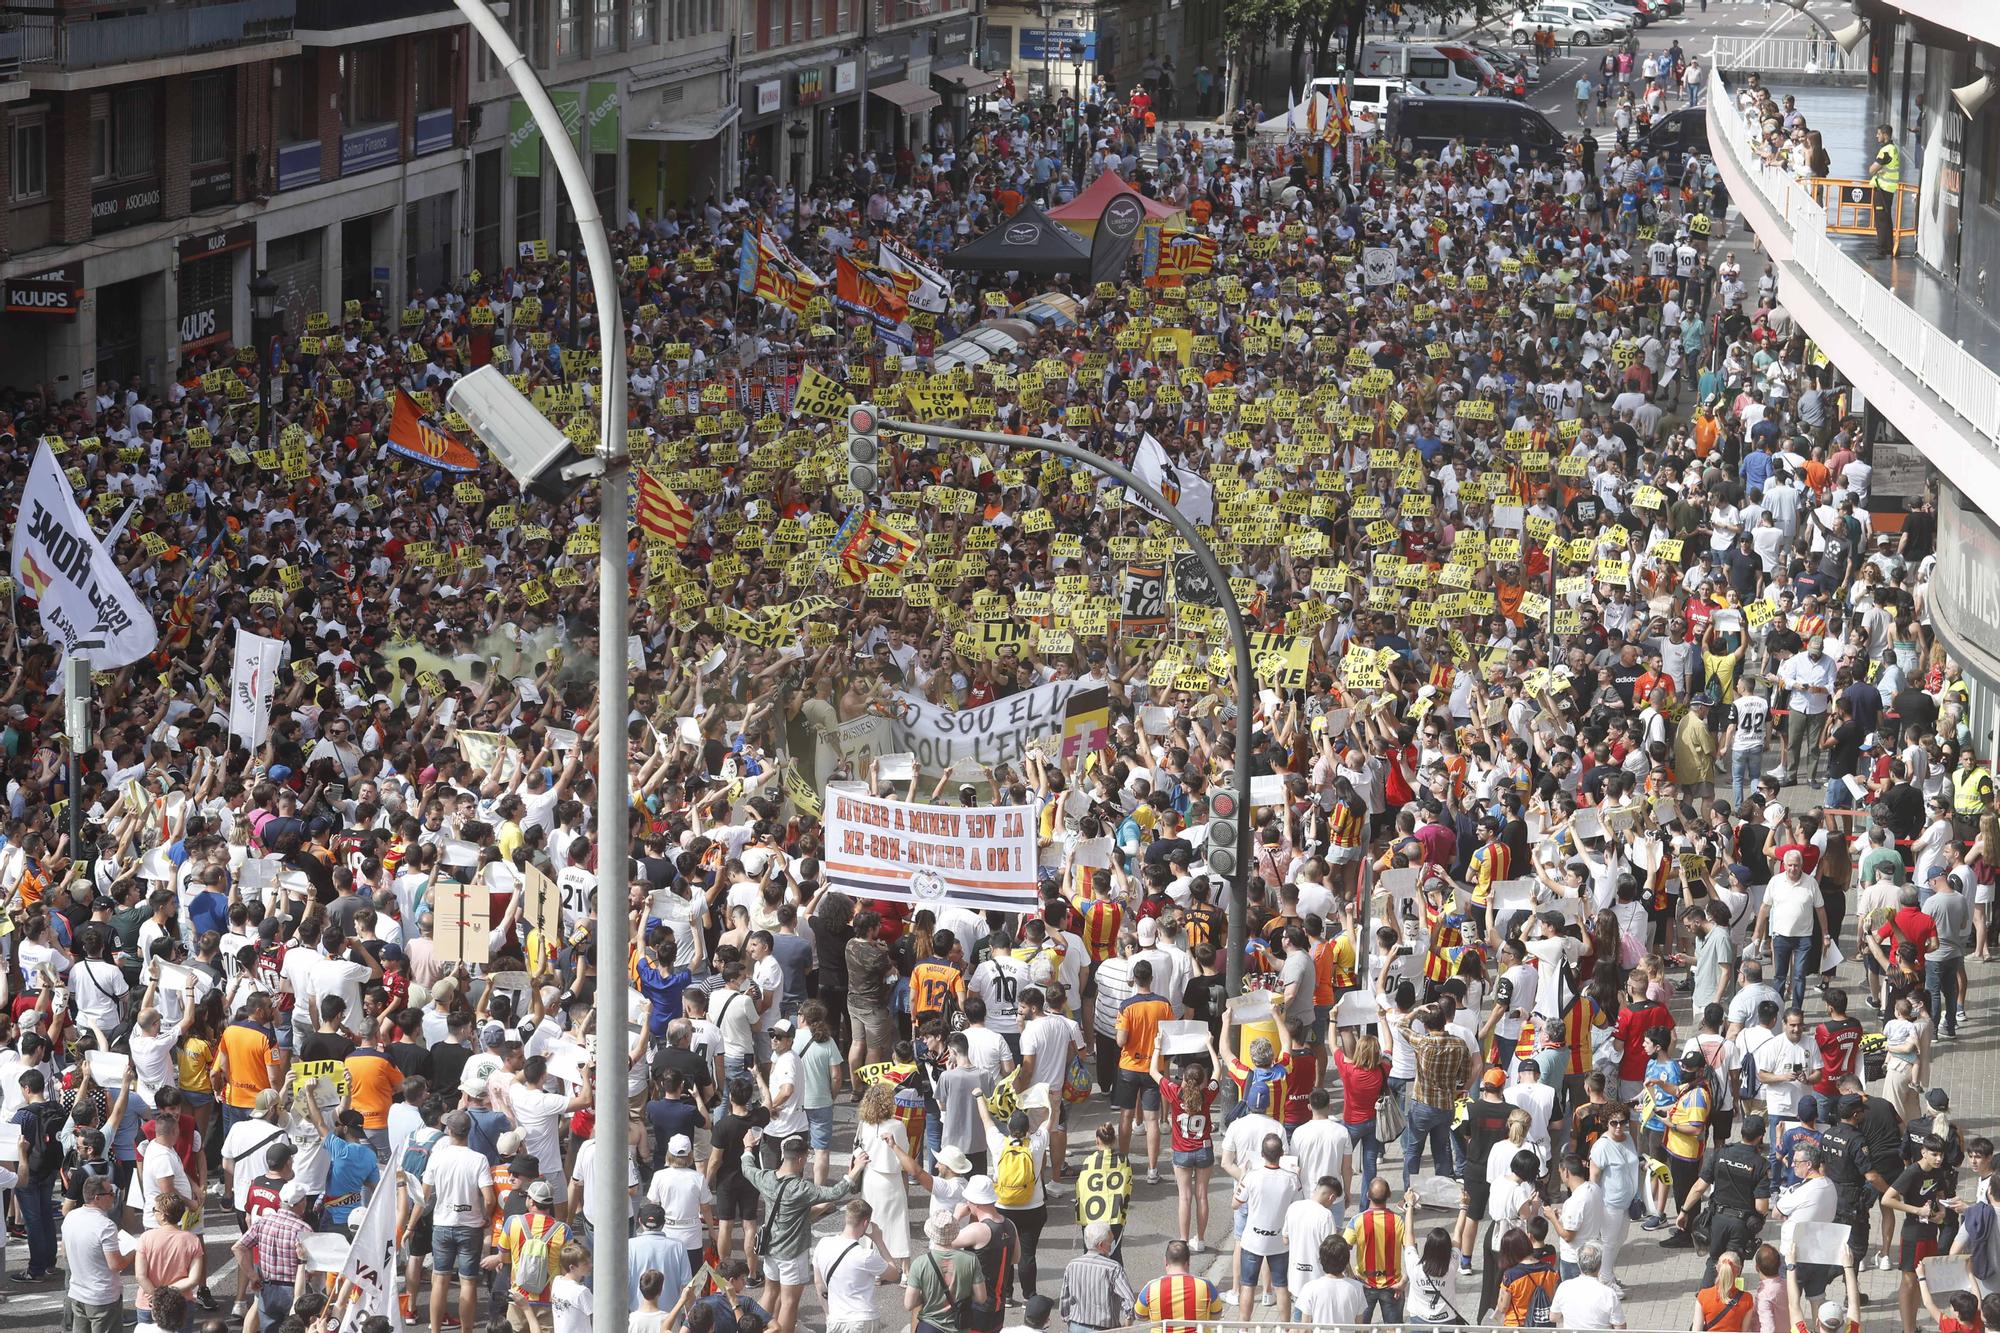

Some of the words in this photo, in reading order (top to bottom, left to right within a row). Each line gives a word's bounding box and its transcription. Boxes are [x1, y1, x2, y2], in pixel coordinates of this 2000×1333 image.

[588, 94, 618, 126] Resa
[344, 140, 364, 158] Solmar
[364, 136, 387, 150] Finance
[126, 190, 160, 209] ASOCIADOS
[208, 234, 226, 250] KUUPS
[1655, 251, 1665, 262] 10
[1681, 256, 1691, 266] 10
[12, 290, 68, 308] KUUPS
[182, 309, 215, 341] KUUPS
[813, 375, 847, 398] LIM
[819, 391, 837, 401] GO
[1546, 396, 1557, 409] 10
[797, 397, 849, 419] HOME
[1029, 510, 1045, 519] LIM
[1026, 522, 1054, 531] HOME
[1372, 521, 1389, 531] LIM
[776, 533, 806, 541] HOME
[1372, 531, 1397, 544] HOME
[682, 584, 695, 593] LIM
[1127, 577, 1161, 598] FC
[682, 597, 705, 607] HOME
[980, 597, 1000, 605] LIM
[1751, 600, 1767, 612] LIM
[1751, 609, 1776, 626] HOME
[960, 635, 975, 645] LIM
[984, 624, 1030, 642] LIM
[956, 647, 980, 659] HOME
[1182, 666, 1202, 674] LIM
[1176, 681, 1208, 690] HOME
[934, 707, 994, 733] SOU
[1009, 693, 1042, 724] EL
[1740, 713, 1764, 733] 42
[904, 732, 951, 768] SOU
[564, 874, 584, 884] AIMAR
[563, 885, 583, 912] 21
[926, 966, 947, 975] MIGUEL
[924, 979, 946, 1007] 12
[991, 977, 1017, 1004] 10
[1837, 1032, 1857, 1041] GUEDES
[1840, 1042, 1854, 1071] 7
[303, 1062, 334, 1076] LIM
[1177, 1113, 1206, 1139] 19
[1087, 1172, 1124, 1191] GO
[253, 1188, 276, 1202] VICENTE
[1423, 1290, 1440, 1310] 7
